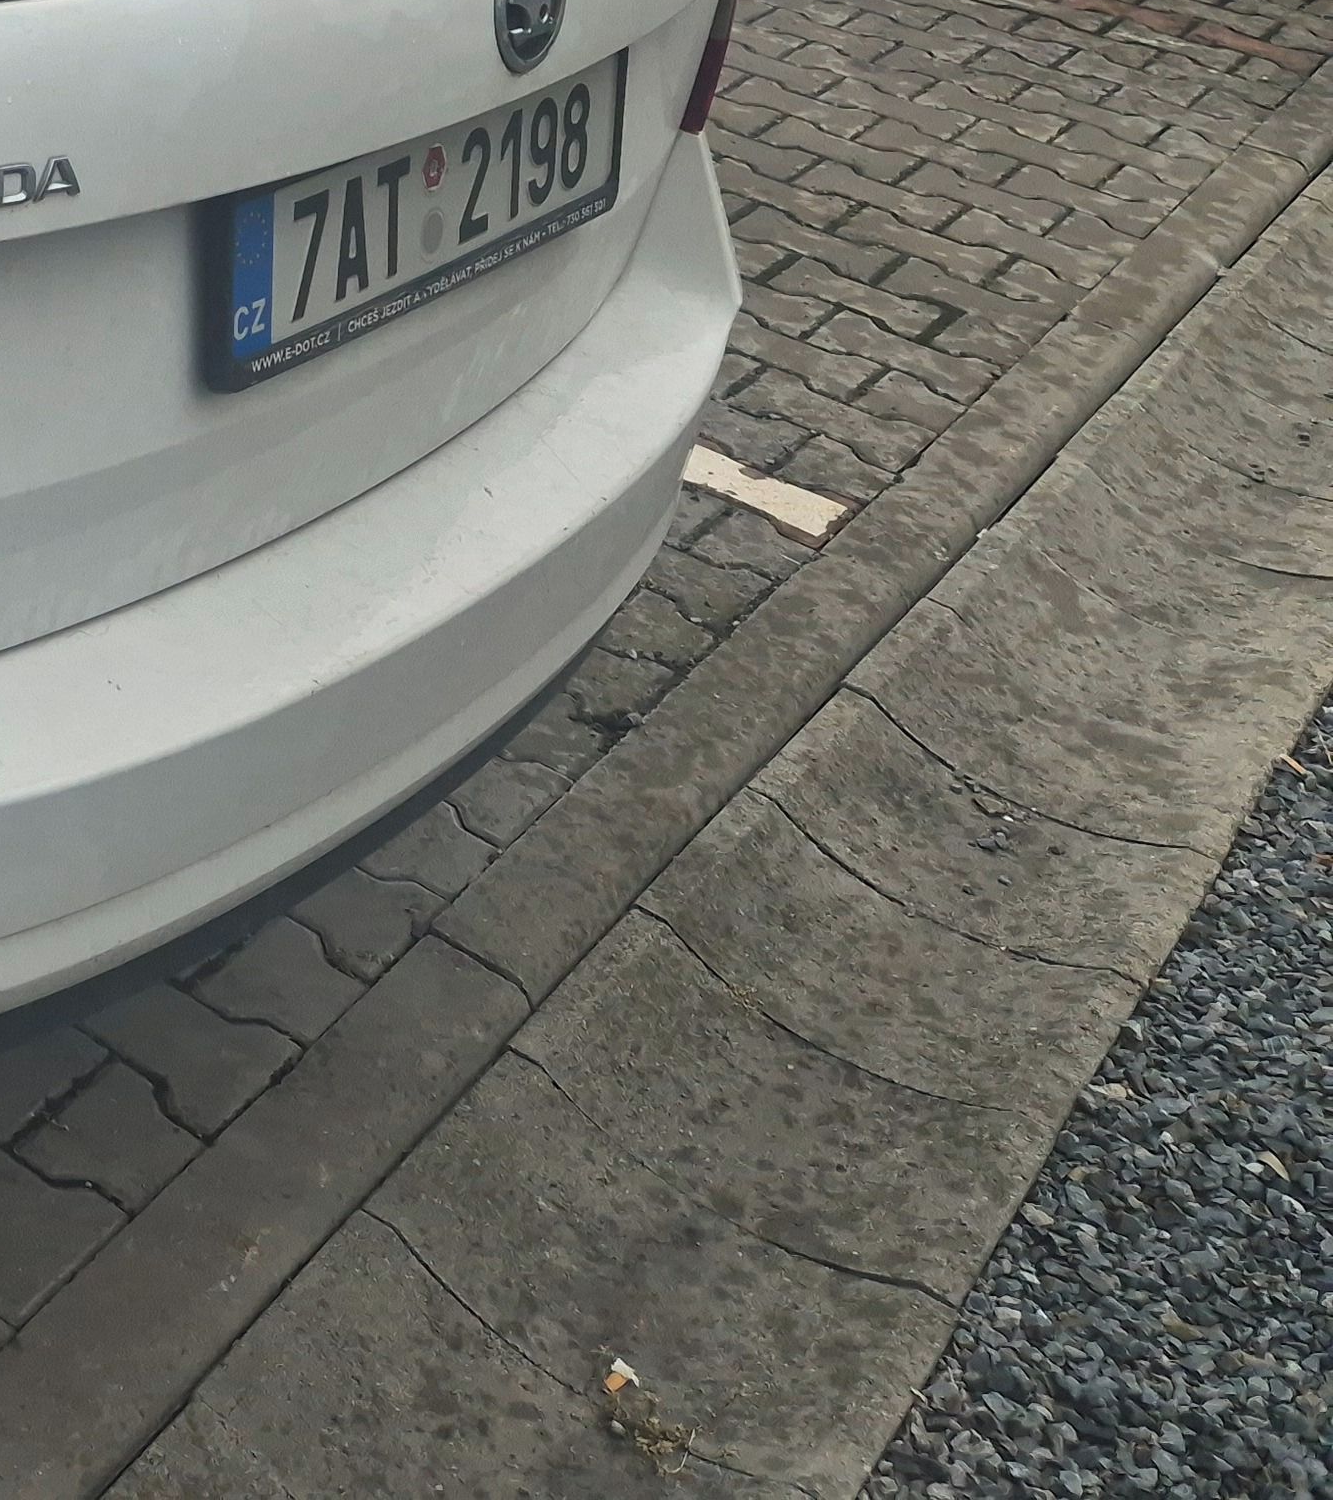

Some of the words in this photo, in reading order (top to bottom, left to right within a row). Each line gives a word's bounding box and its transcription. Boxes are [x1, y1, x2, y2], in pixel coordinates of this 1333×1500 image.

[289, 155, 411, 323] 7AT
[457, 83, 591, 245] 2198
[233, 298, 266, 341] CZ
[251, 330, 331, 373] WWW.E-DOT.CZ
[347, 307, 379, 333] CHCEŠ
[380, 295, 412, 319] JEZDIT
[413, 291, 421, 303] A
